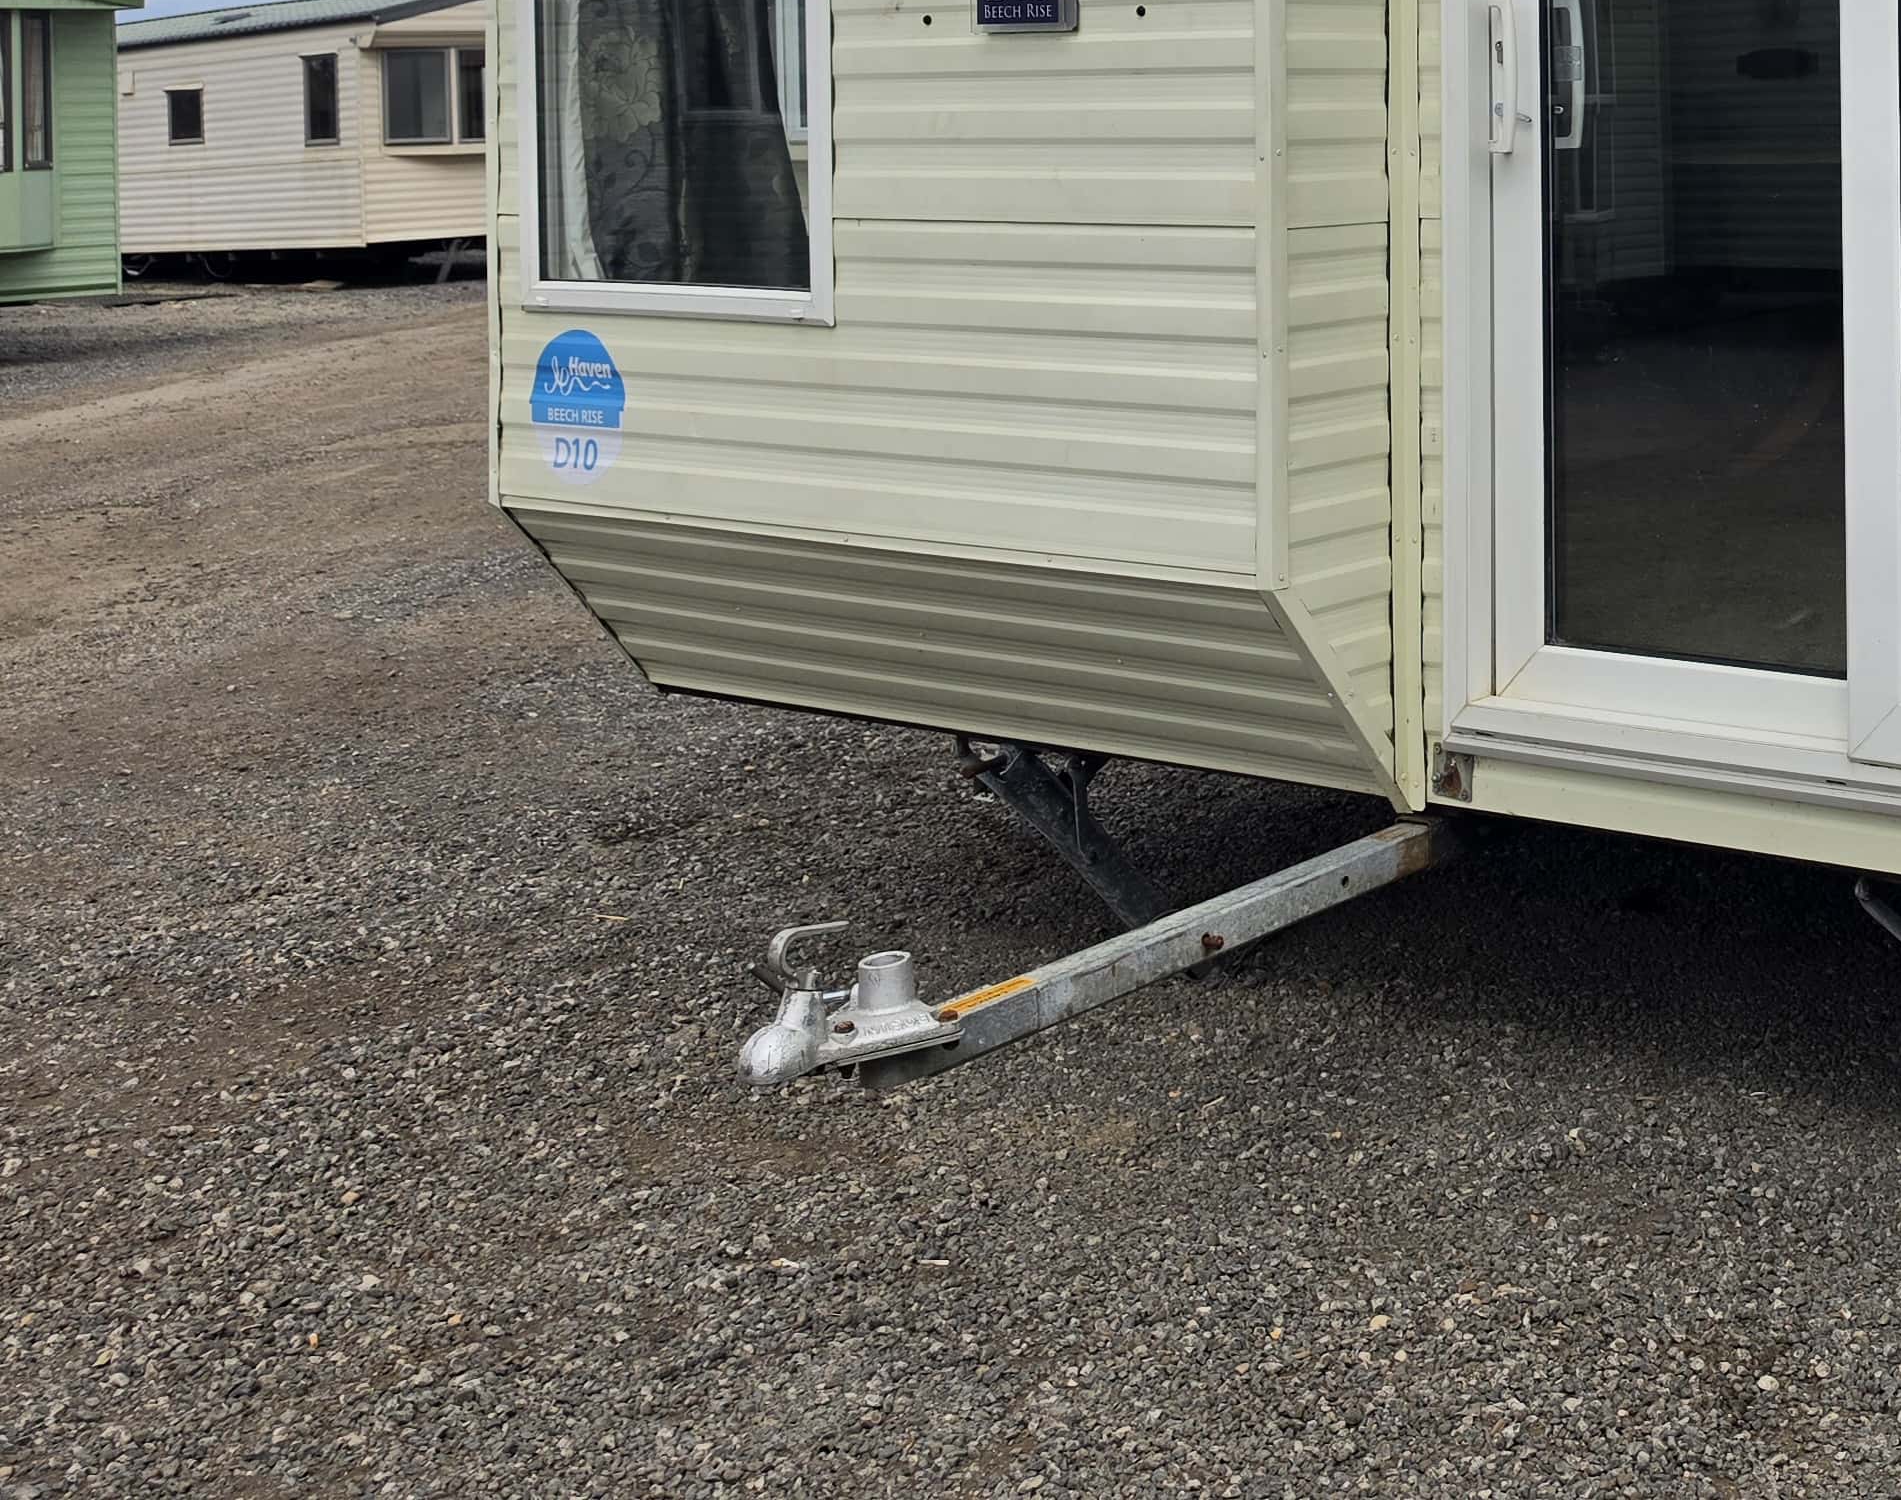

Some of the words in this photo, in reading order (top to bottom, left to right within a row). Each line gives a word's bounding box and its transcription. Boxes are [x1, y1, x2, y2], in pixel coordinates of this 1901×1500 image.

[983, 4, 1022, 19] BEECH
[1026, 3, 1053, 18] RISE
[568, 356, 612, 379] Haven
[547, 407, 579, 422] BEECH
[581, 409, 604, 424] RISE
[553, 437, 599, 471] D10
